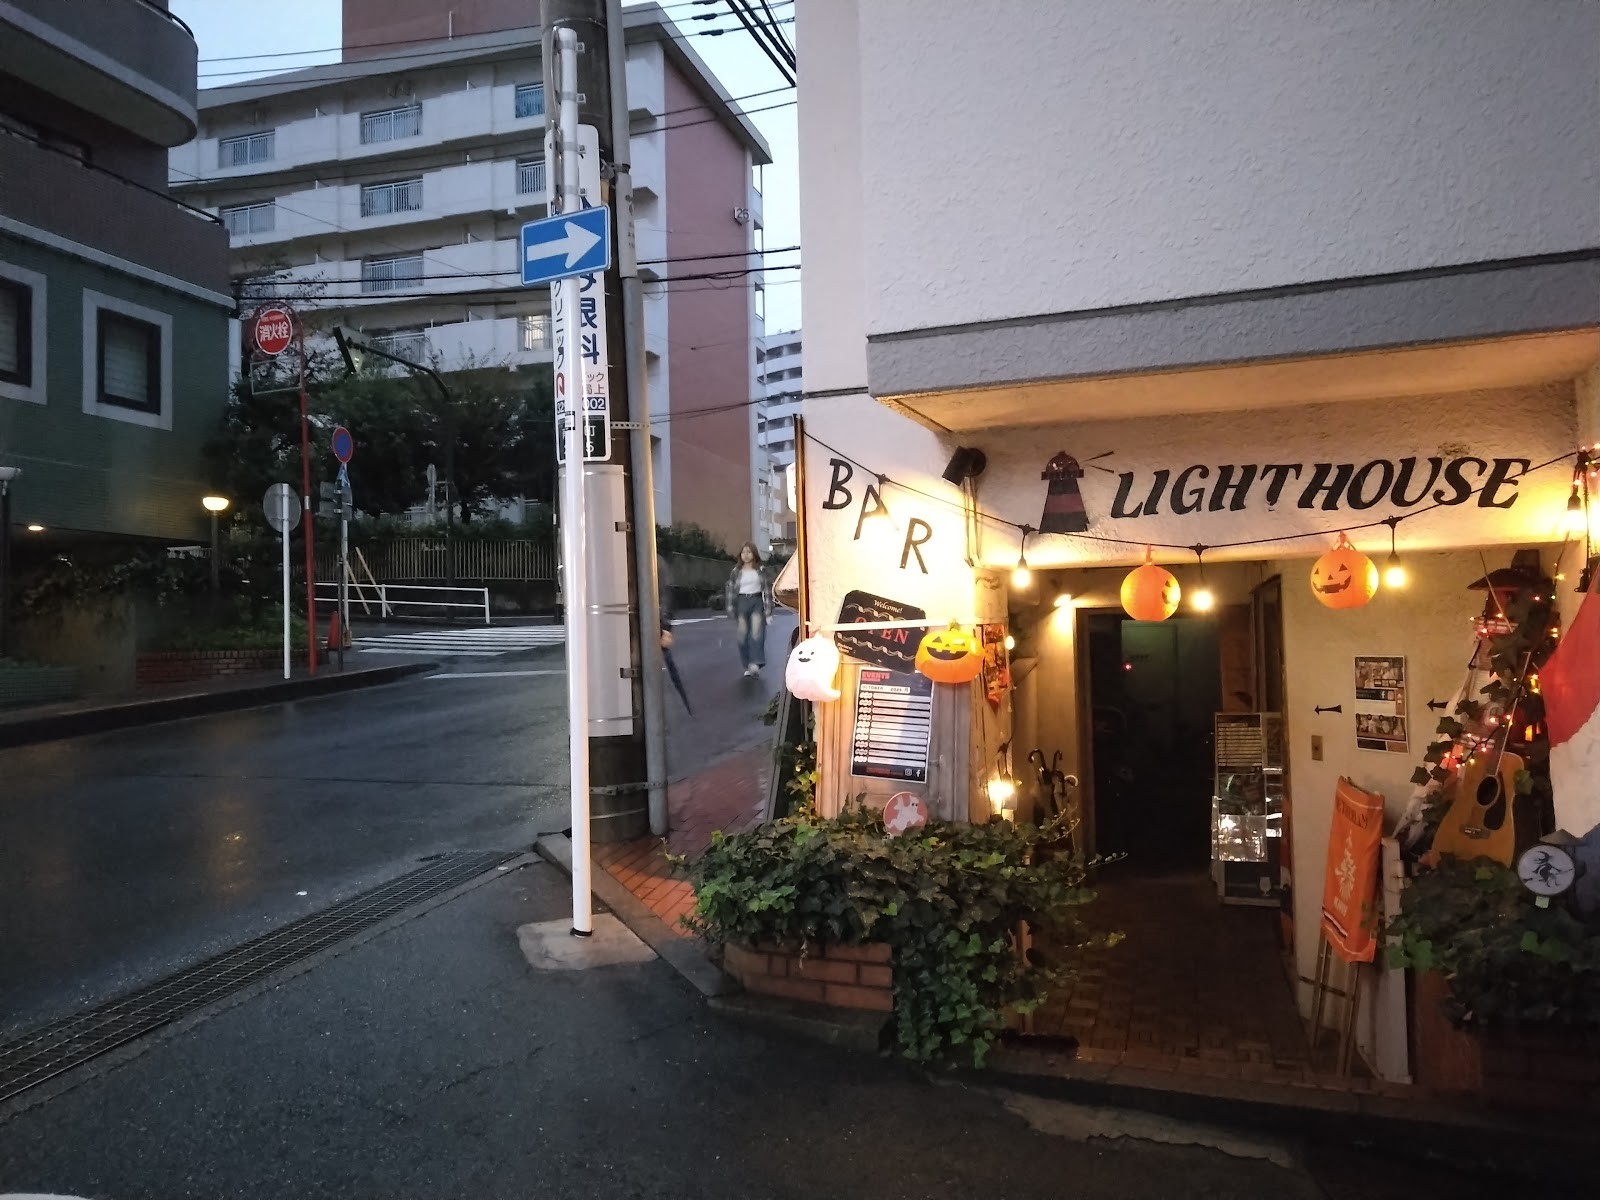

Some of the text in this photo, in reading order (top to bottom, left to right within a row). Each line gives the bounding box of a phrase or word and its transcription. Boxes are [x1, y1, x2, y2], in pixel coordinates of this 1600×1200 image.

[736, 207, 750, 220] 26
[259, 322, 289, 342] 消火栓
[1111, 456, 1532, 519] LIGHTHOUSE
[822, 458, 932, 574] BAR
[874, 600, 903, 613] Welcome!
